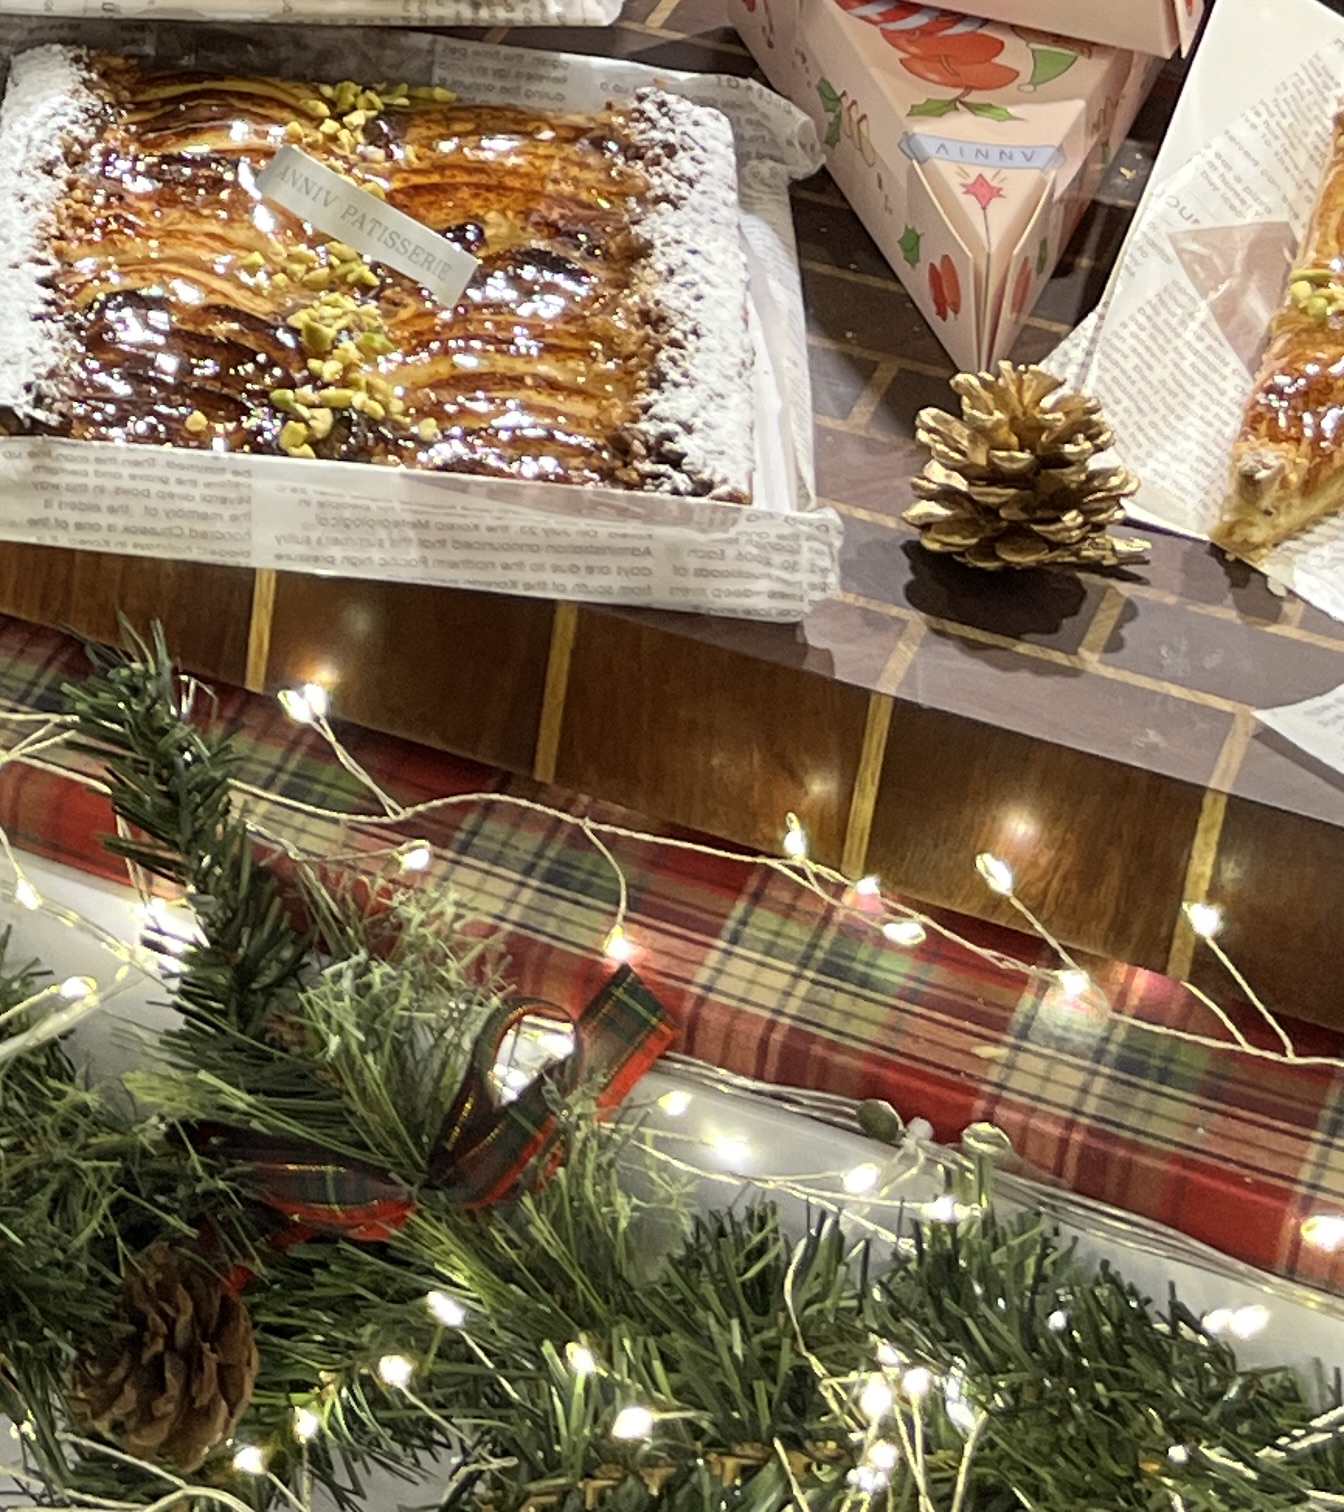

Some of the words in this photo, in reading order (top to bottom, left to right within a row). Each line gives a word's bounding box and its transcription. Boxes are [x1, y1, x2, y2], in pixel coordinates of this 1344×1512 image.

[935, 142, 1037, 162] ANNIV
[280, 164, 338, 209] ANNIV
[340, 203, 453, 281] PATISSERIE
